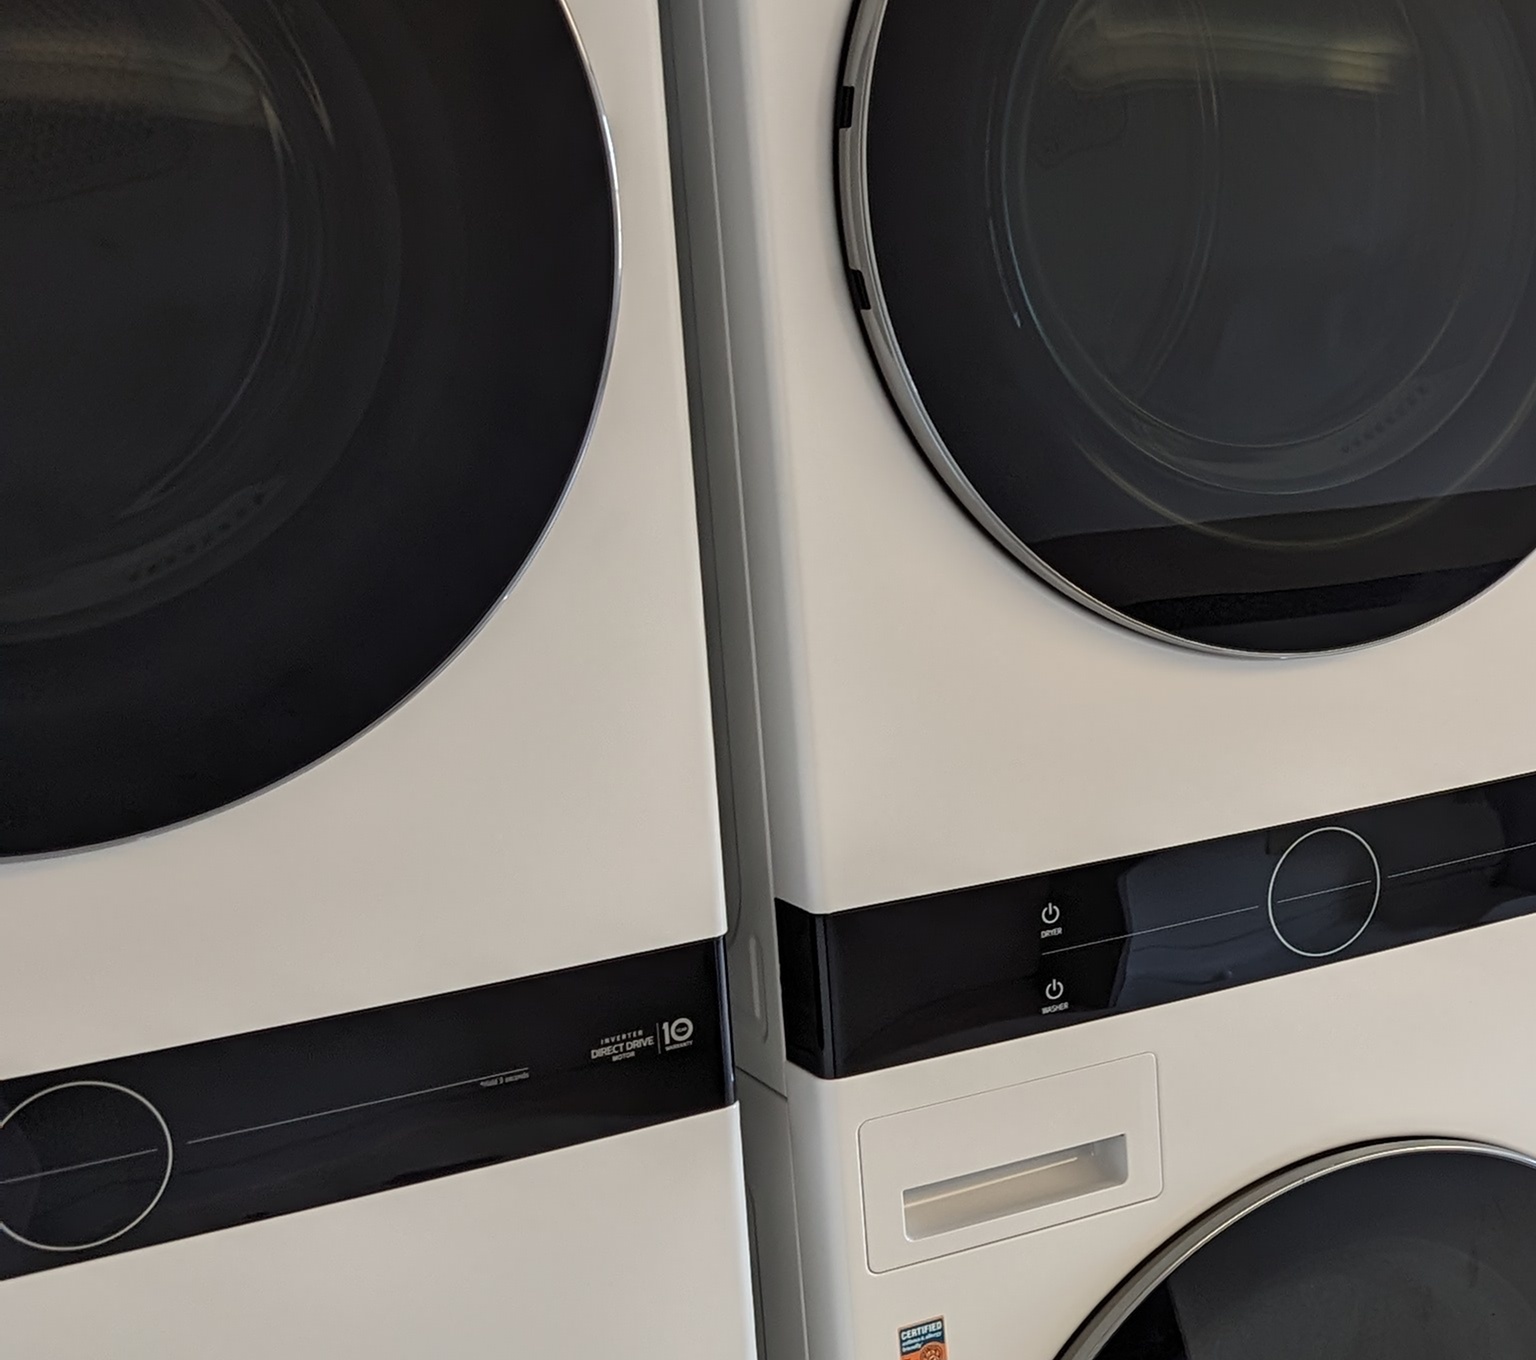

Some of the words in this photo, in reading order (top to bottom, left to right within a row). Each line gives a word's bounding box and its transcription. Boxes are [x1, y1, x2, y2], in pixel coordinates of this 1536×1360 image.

[1040, 927, 1063, 939] DRYER
[1041, 1001, 1069, 1015] WASHER
[600, 1029, 643, 1045] INVERTER
[662, 1017, 694, 1045] 10
[590, 1042, 625, 1060] DIRECT
[625, 1036, 655, 1051] DRIVE
[611, 1050, 636, 1062] MOTOR
[901, 1320, 942, 1341] CERTIFIED
